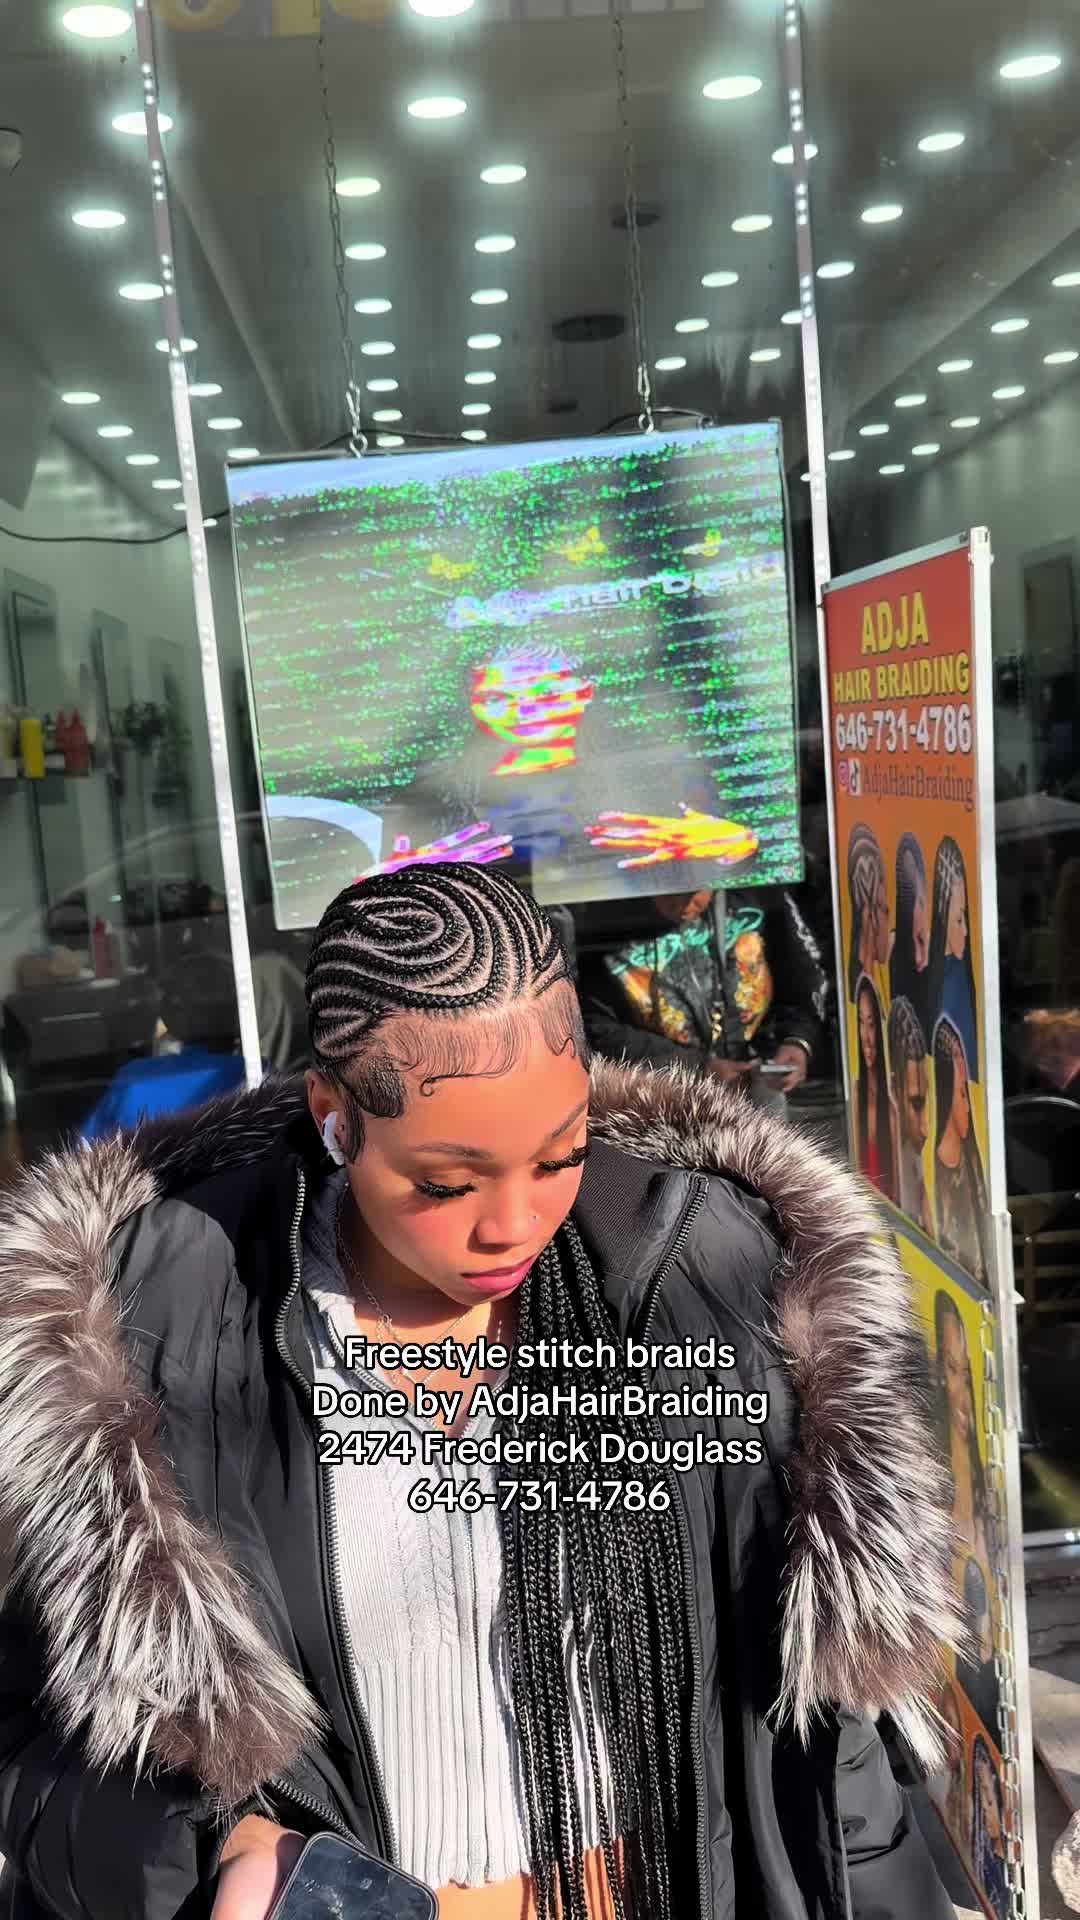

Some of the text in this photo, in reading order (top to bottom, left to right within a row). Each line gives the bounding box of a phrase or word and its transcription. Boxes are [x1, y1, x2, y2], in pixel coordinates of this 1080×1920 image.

[861, 591, 929, 654] ADJA
[834, 652, 969, 703] HAIR BRAIDING
[835, 704, 971, 753] 646-731-4786
